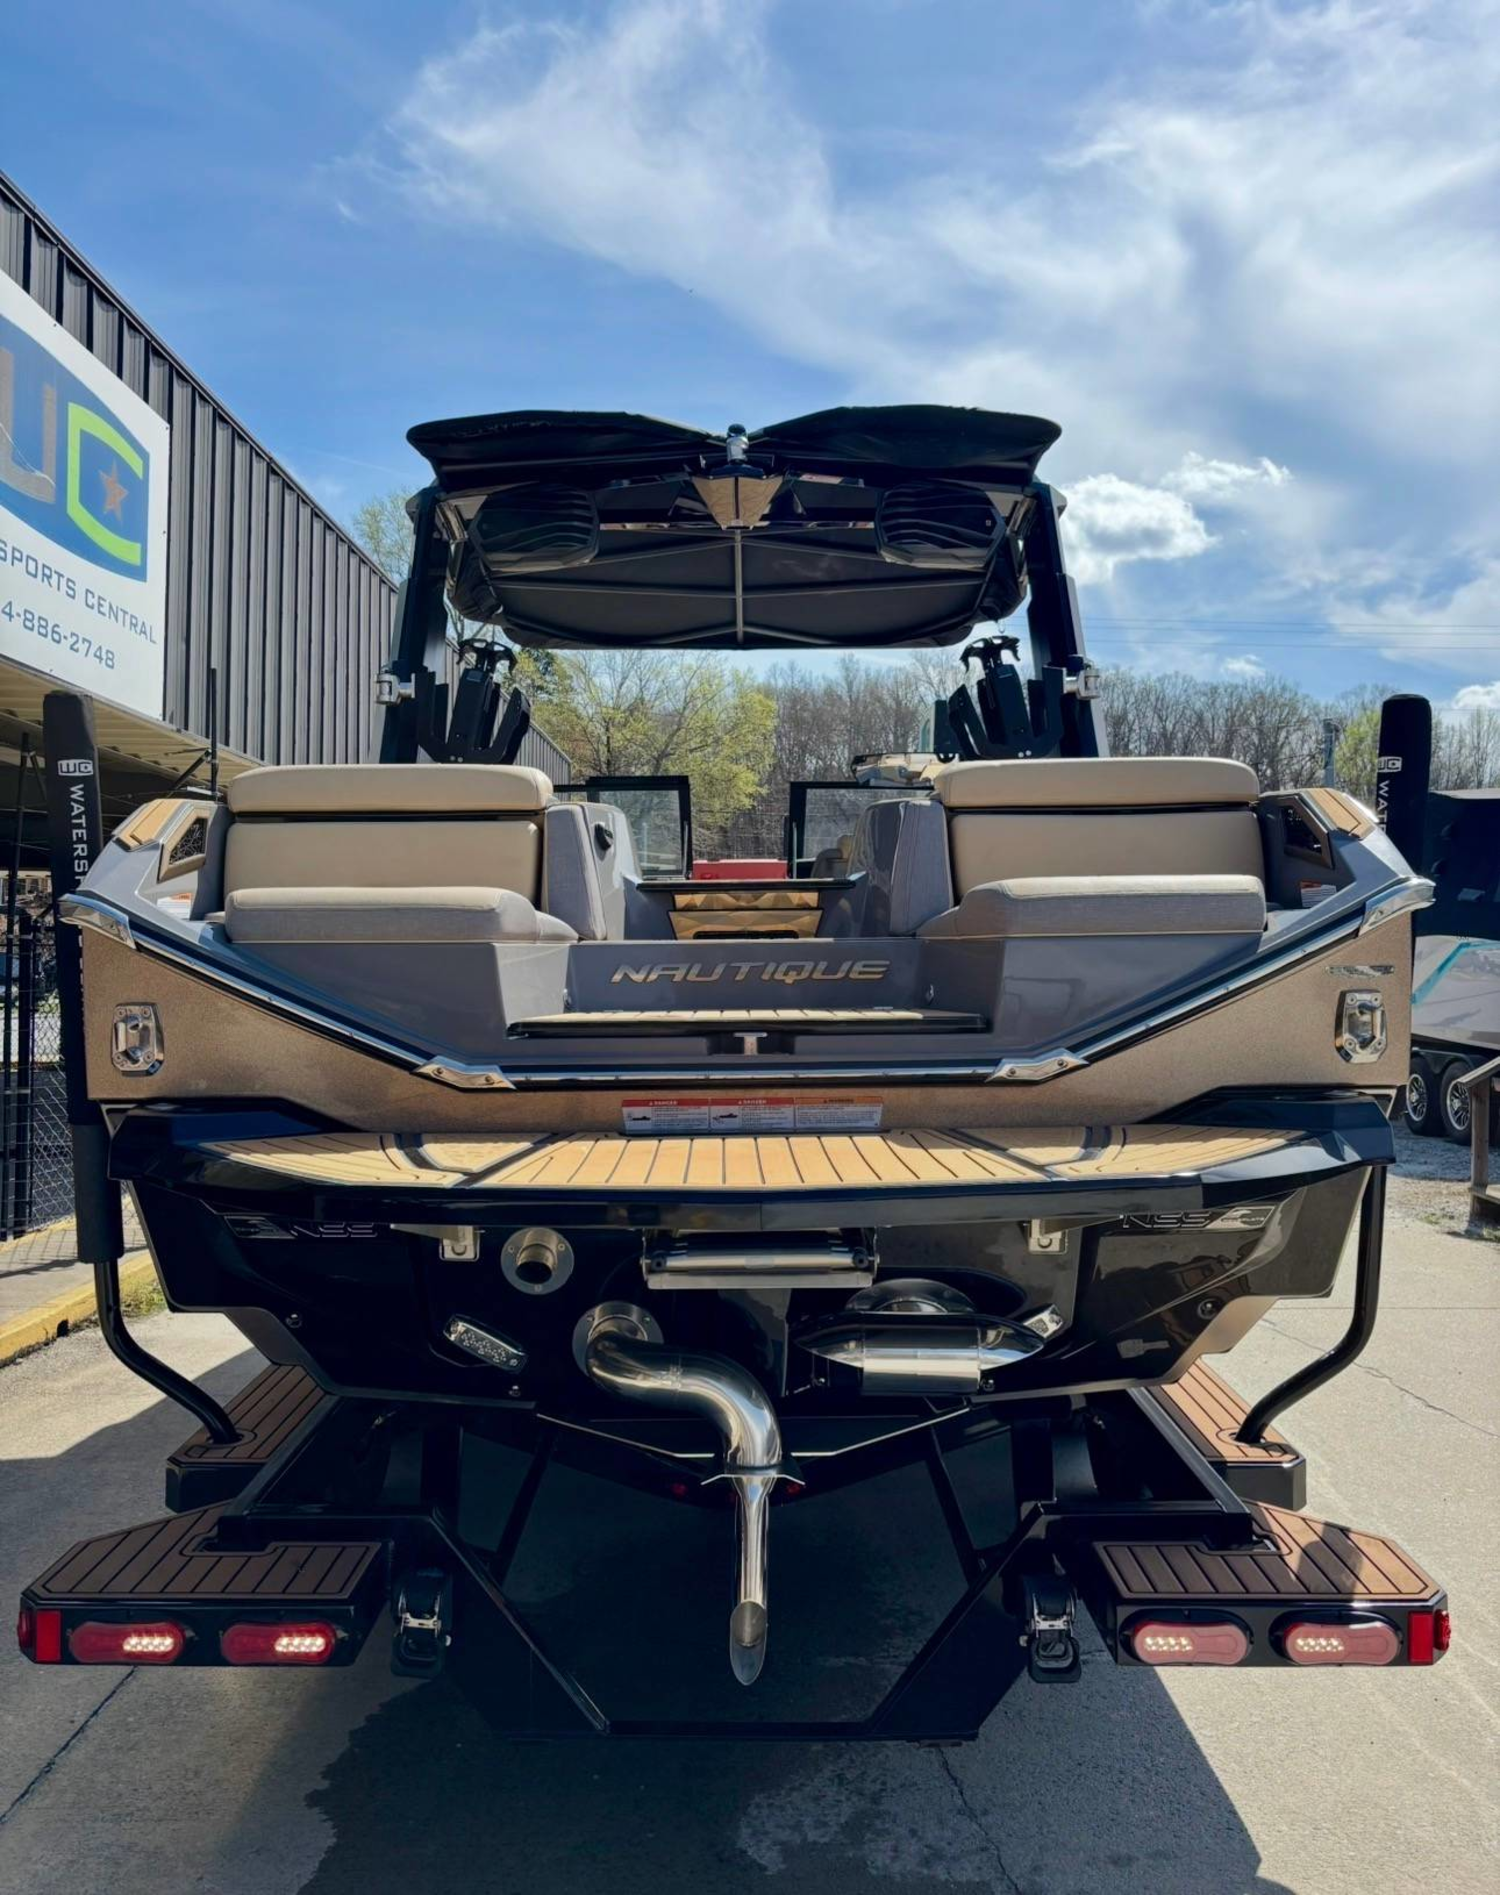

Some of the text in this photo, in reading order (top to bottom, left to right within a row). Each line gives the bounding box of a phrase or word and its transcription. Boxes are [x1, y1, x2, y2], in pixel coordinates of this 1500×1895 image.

[1, 600, 116, 669] 4-886-2748
[84, 587, 158, 645] CENTRAL
[610, 960, 890, 984] NAUTIQUE
[1122, 1211, 1212, 1228] NSS
